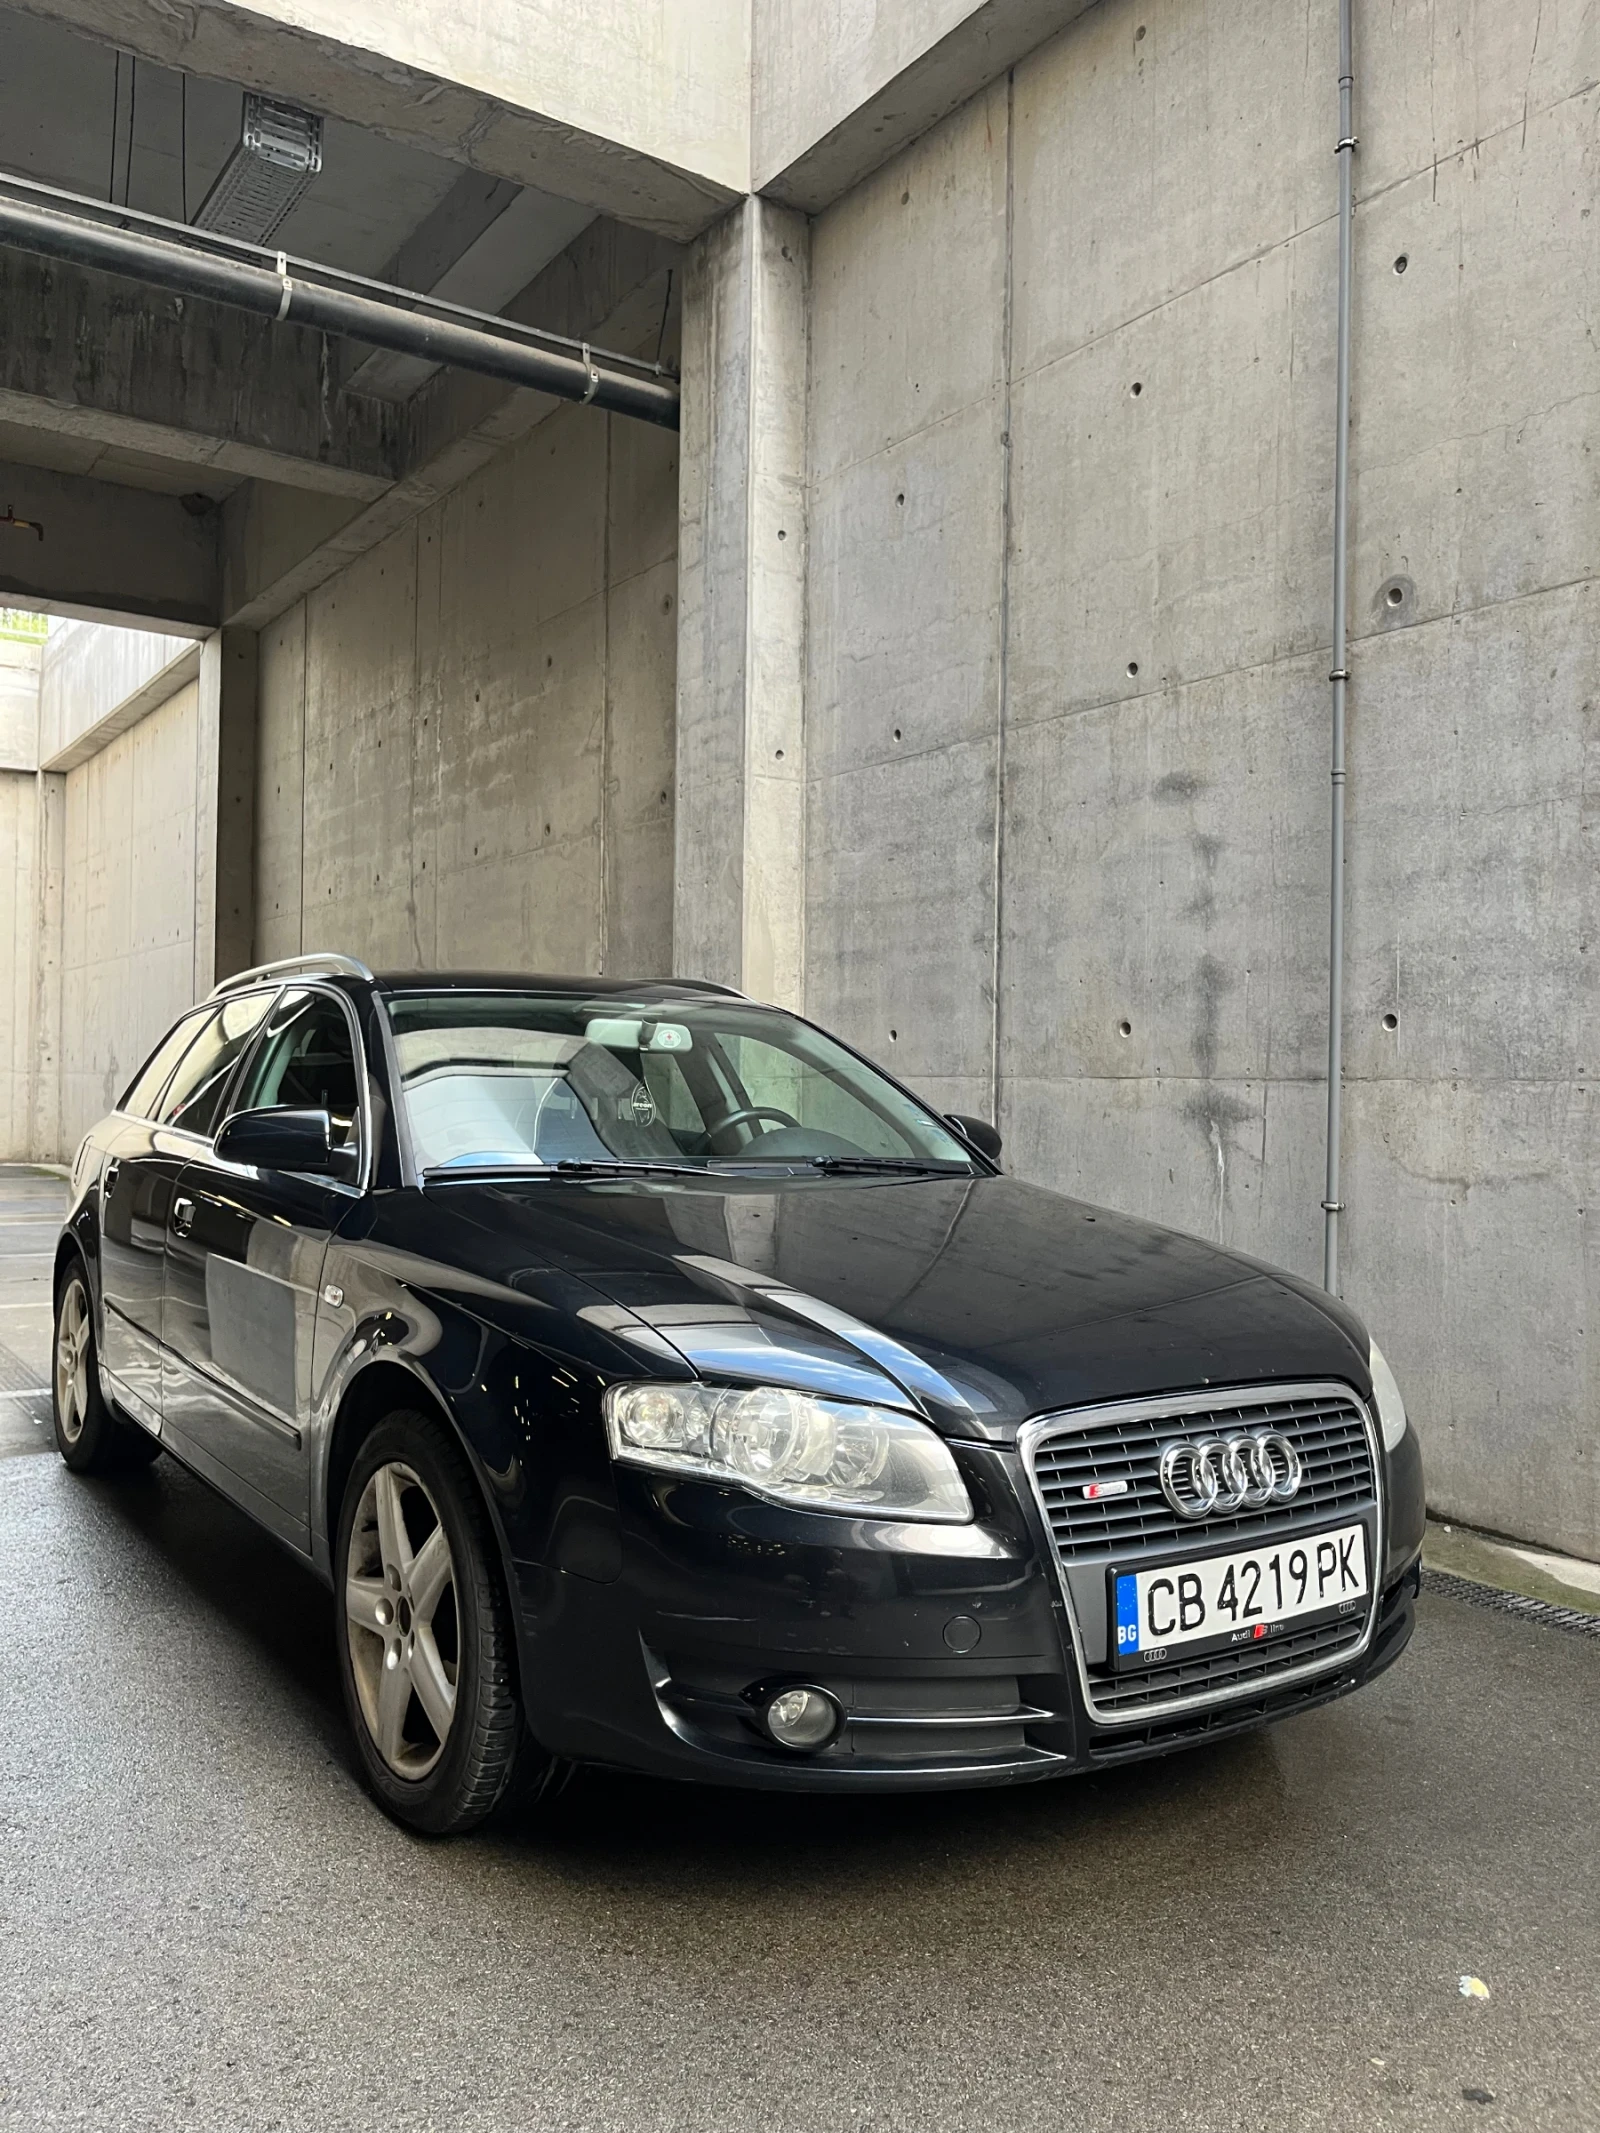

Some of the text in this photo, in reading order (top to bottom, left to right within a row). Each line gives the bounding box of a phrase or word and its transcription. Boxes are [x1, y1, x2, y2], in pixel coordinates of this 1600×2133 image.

[1147, 1534, 1359, 1636] CB 4219 PK
[1117, 1624, 1137, 1645] BG
[1231, 1629, 1251, 1642] Audi
